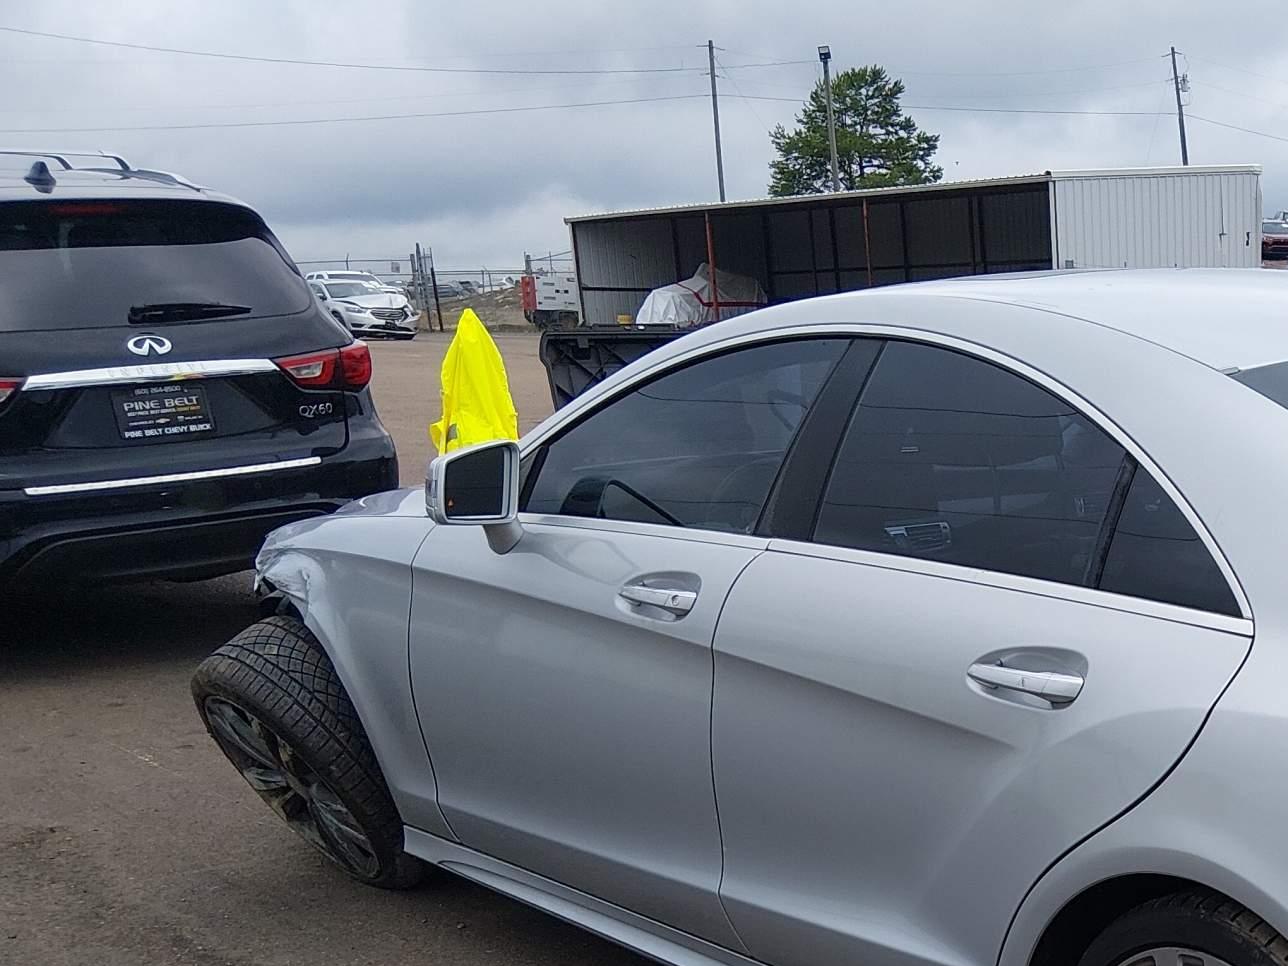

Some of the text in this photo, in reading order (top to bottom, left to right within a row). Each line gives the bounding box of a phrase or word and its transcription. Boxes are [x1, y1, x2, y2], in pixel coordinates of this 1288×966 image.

[123, 399, 160, 411] PINE
[163, 395, 199, 408] BELT
[299, 402, 333, 418] QX60
[124, 430, 143, 439] PINE
[144, 427, 163, 437] BELT
[164, 425, 188, 434] CHEVY
[189, 423, 212, 432] BUICK
